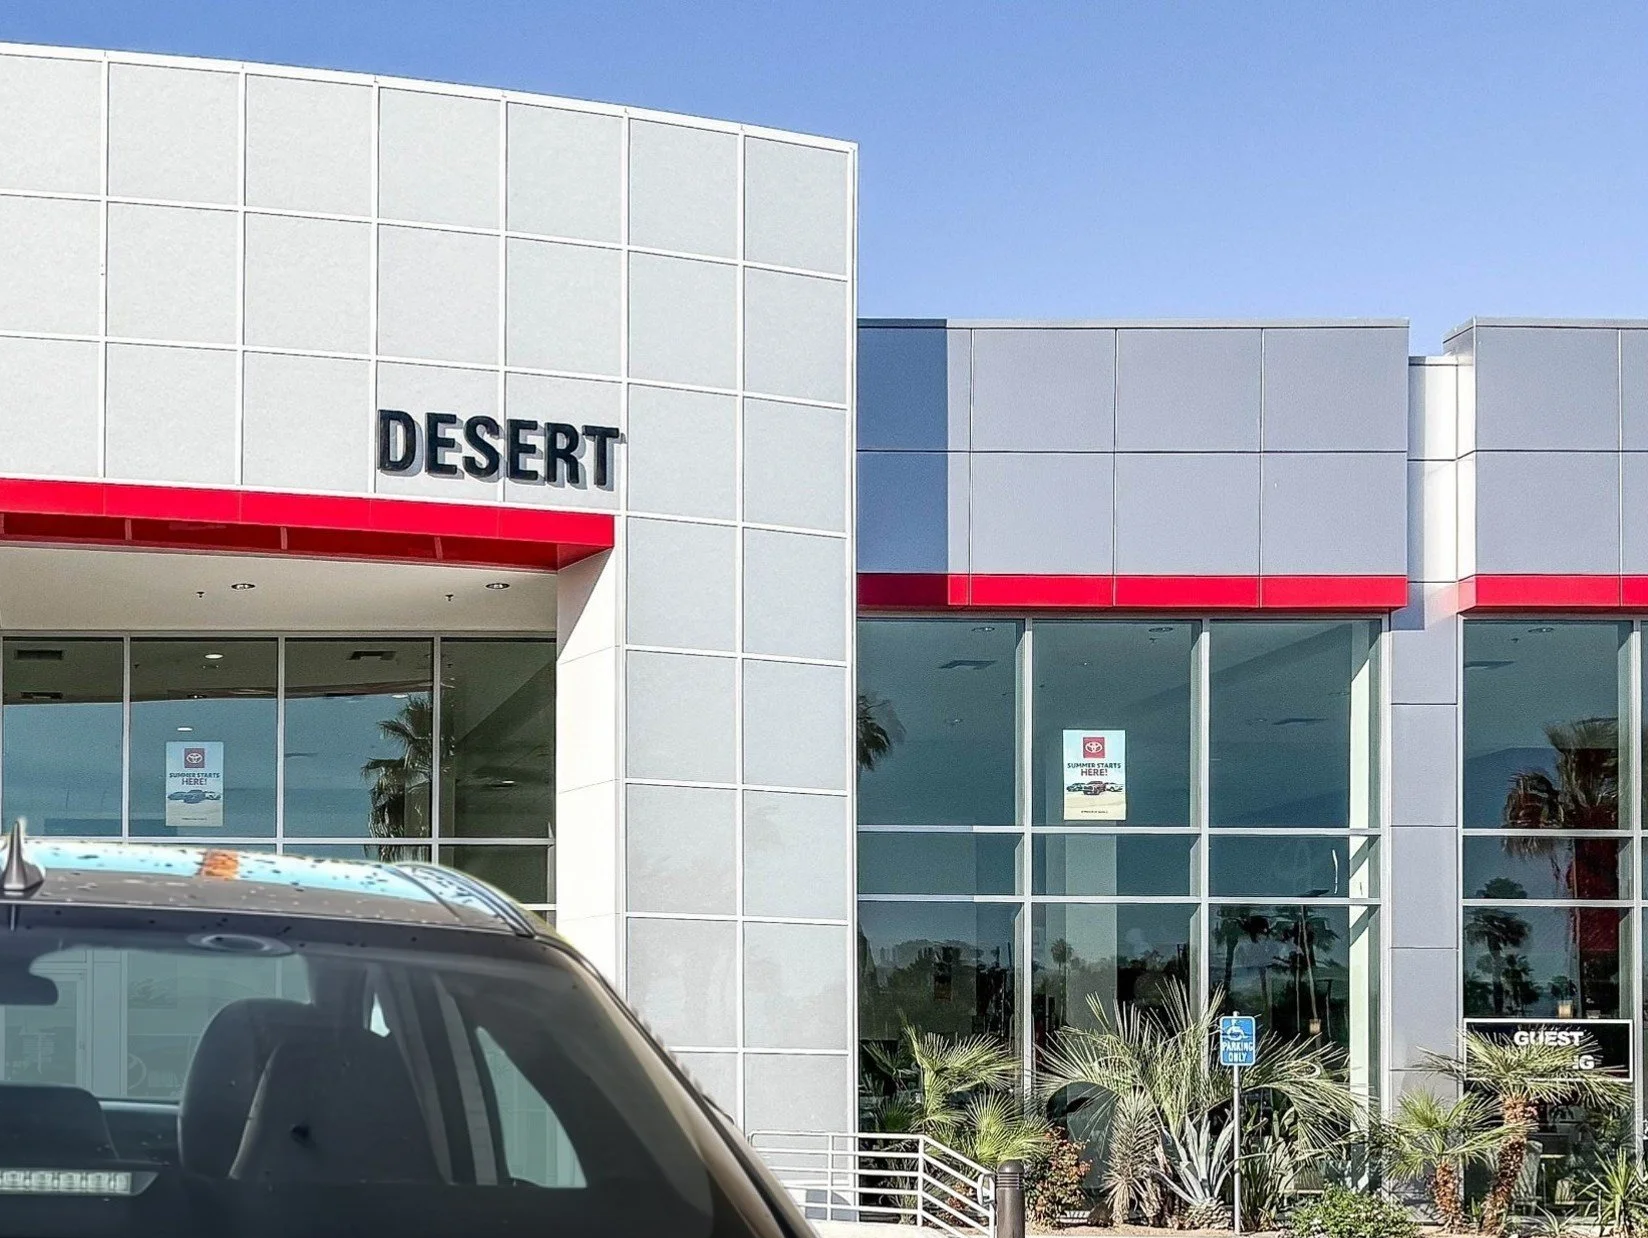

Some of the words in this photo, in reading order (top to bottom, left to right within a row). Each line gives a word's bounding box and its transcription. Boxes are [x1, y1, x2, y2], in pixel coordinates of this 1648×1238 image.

[377, 409, 620, 486] DESERT
[1513, 1030, 1584, 1046] GUEST
[1222, 1040, 1253, 1052] PARKING
[1228, 1051, 1247, 1062] ONLY
